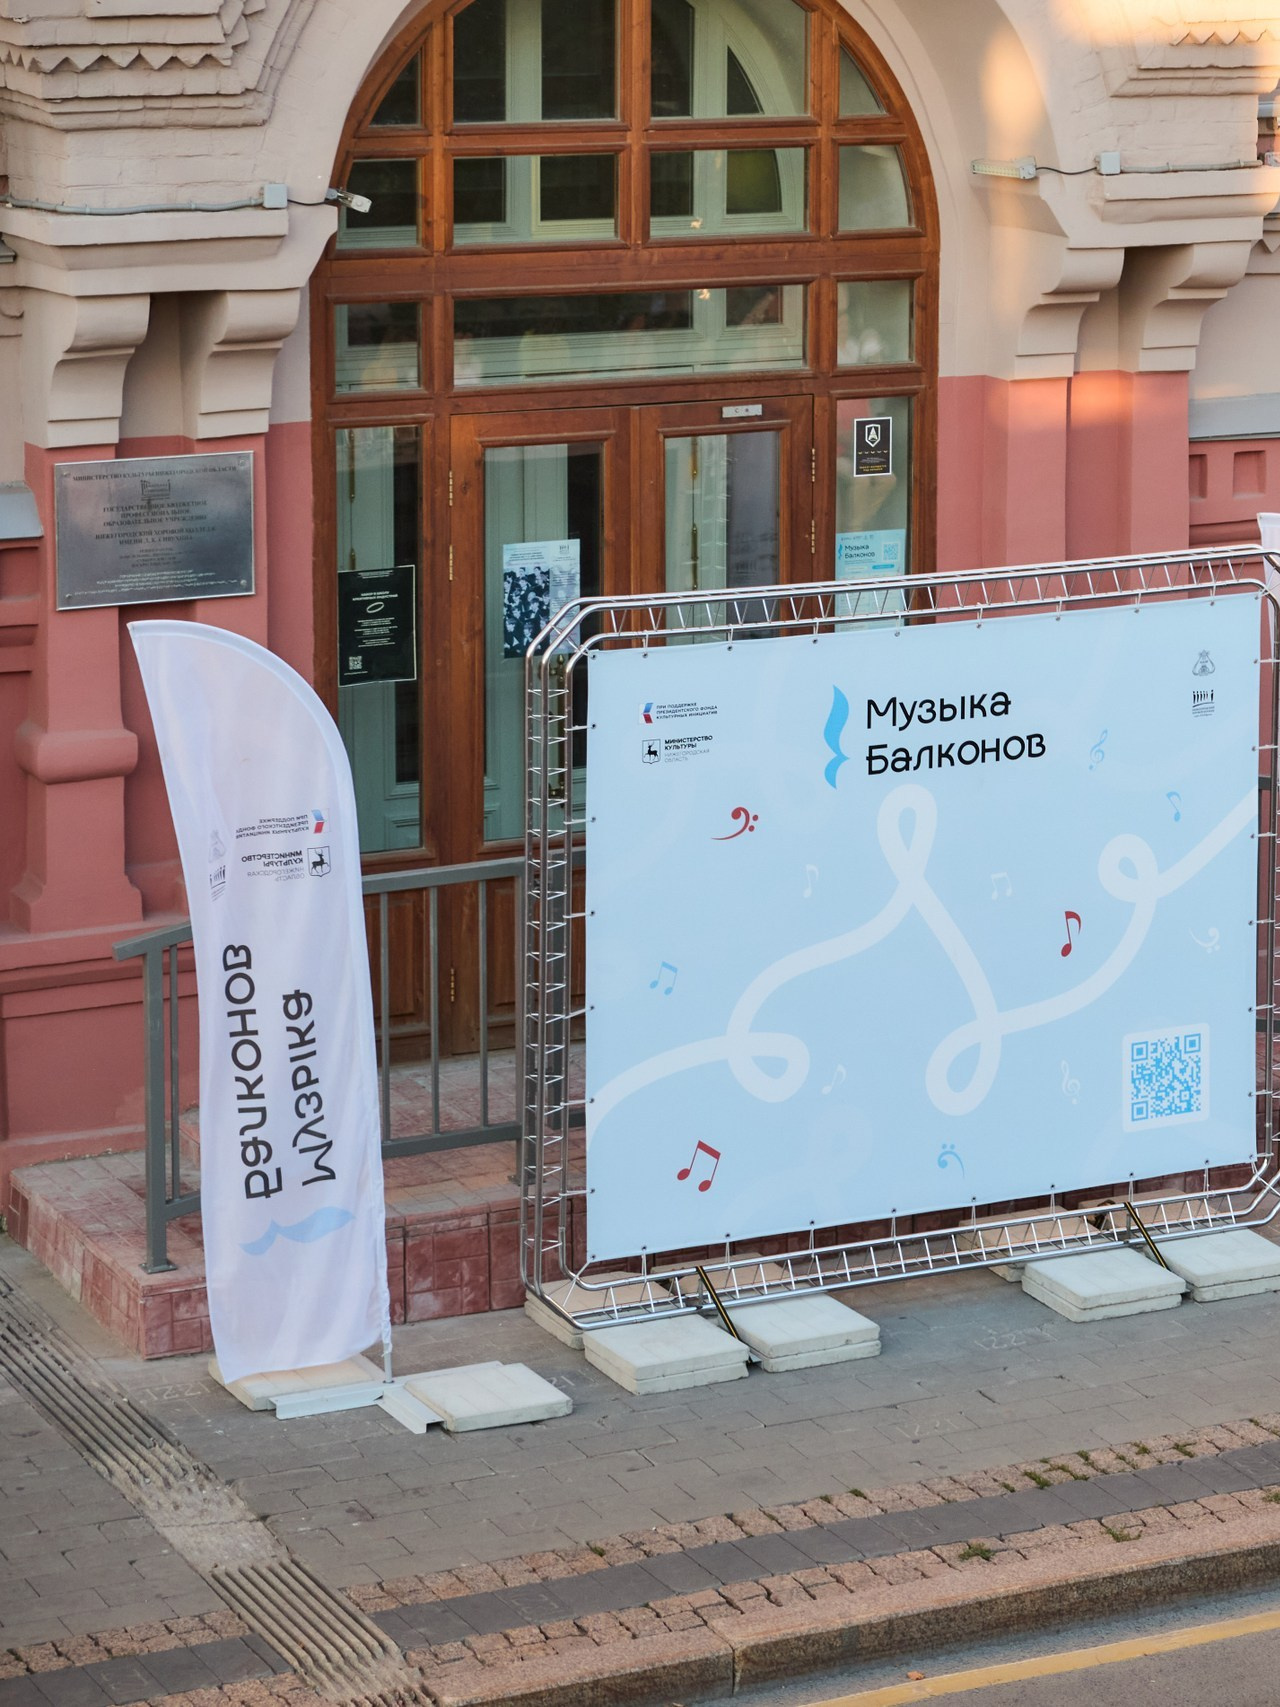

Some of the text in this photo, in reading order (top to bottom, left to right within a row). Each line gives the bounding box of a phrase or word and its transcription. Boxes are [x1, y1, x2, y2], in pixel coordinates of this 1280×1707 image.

[866, 691, 1012, 732] Музыка
[664, 735, 713, 745] МИНИСТЕРСТВО
[664, 743, 697, 751] КУЛЬТУРЫ
[865, 733, 1046, 775] Балконов
